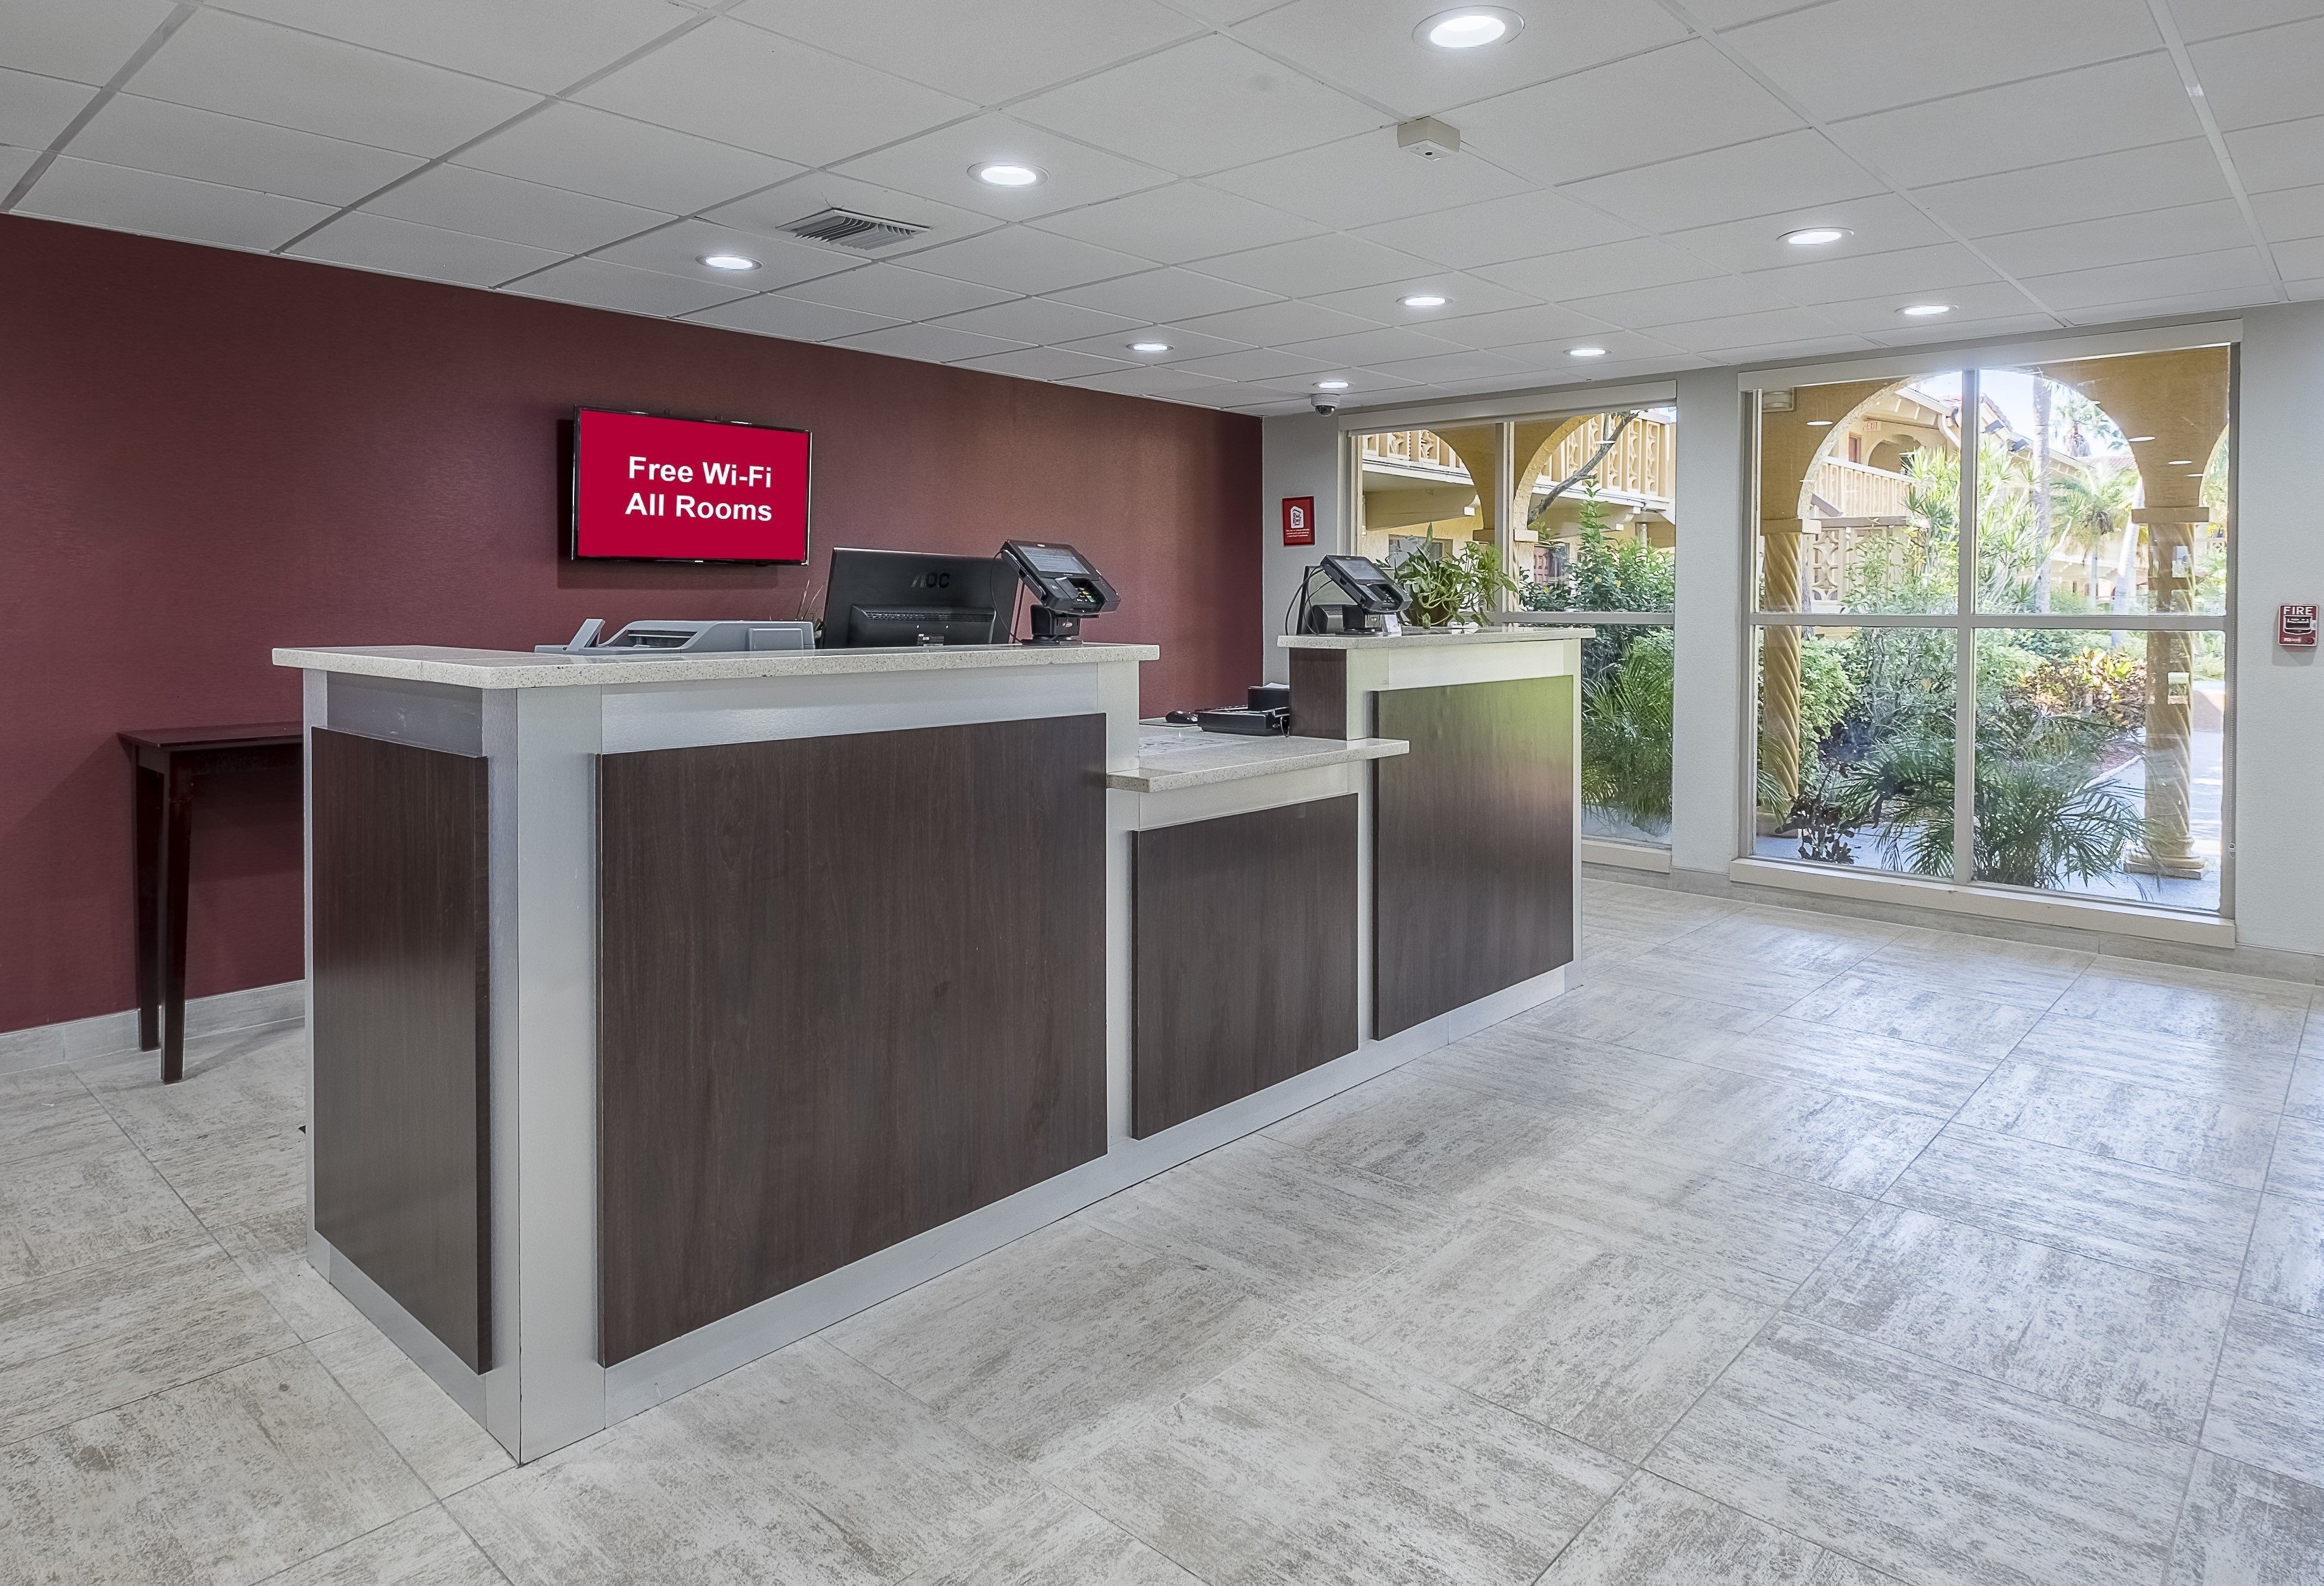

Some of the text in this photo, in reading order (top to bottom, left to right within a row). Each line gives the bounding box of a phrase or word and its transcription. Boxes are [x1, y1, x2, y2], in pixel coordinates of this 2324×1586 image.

[629, 456, 771, 488] Free Wi-Fi
[625, 492, 772, 521] All Rooms
[911, 572, 950, 588] AOC
[2283, 606, 2313, 615] FIRE
